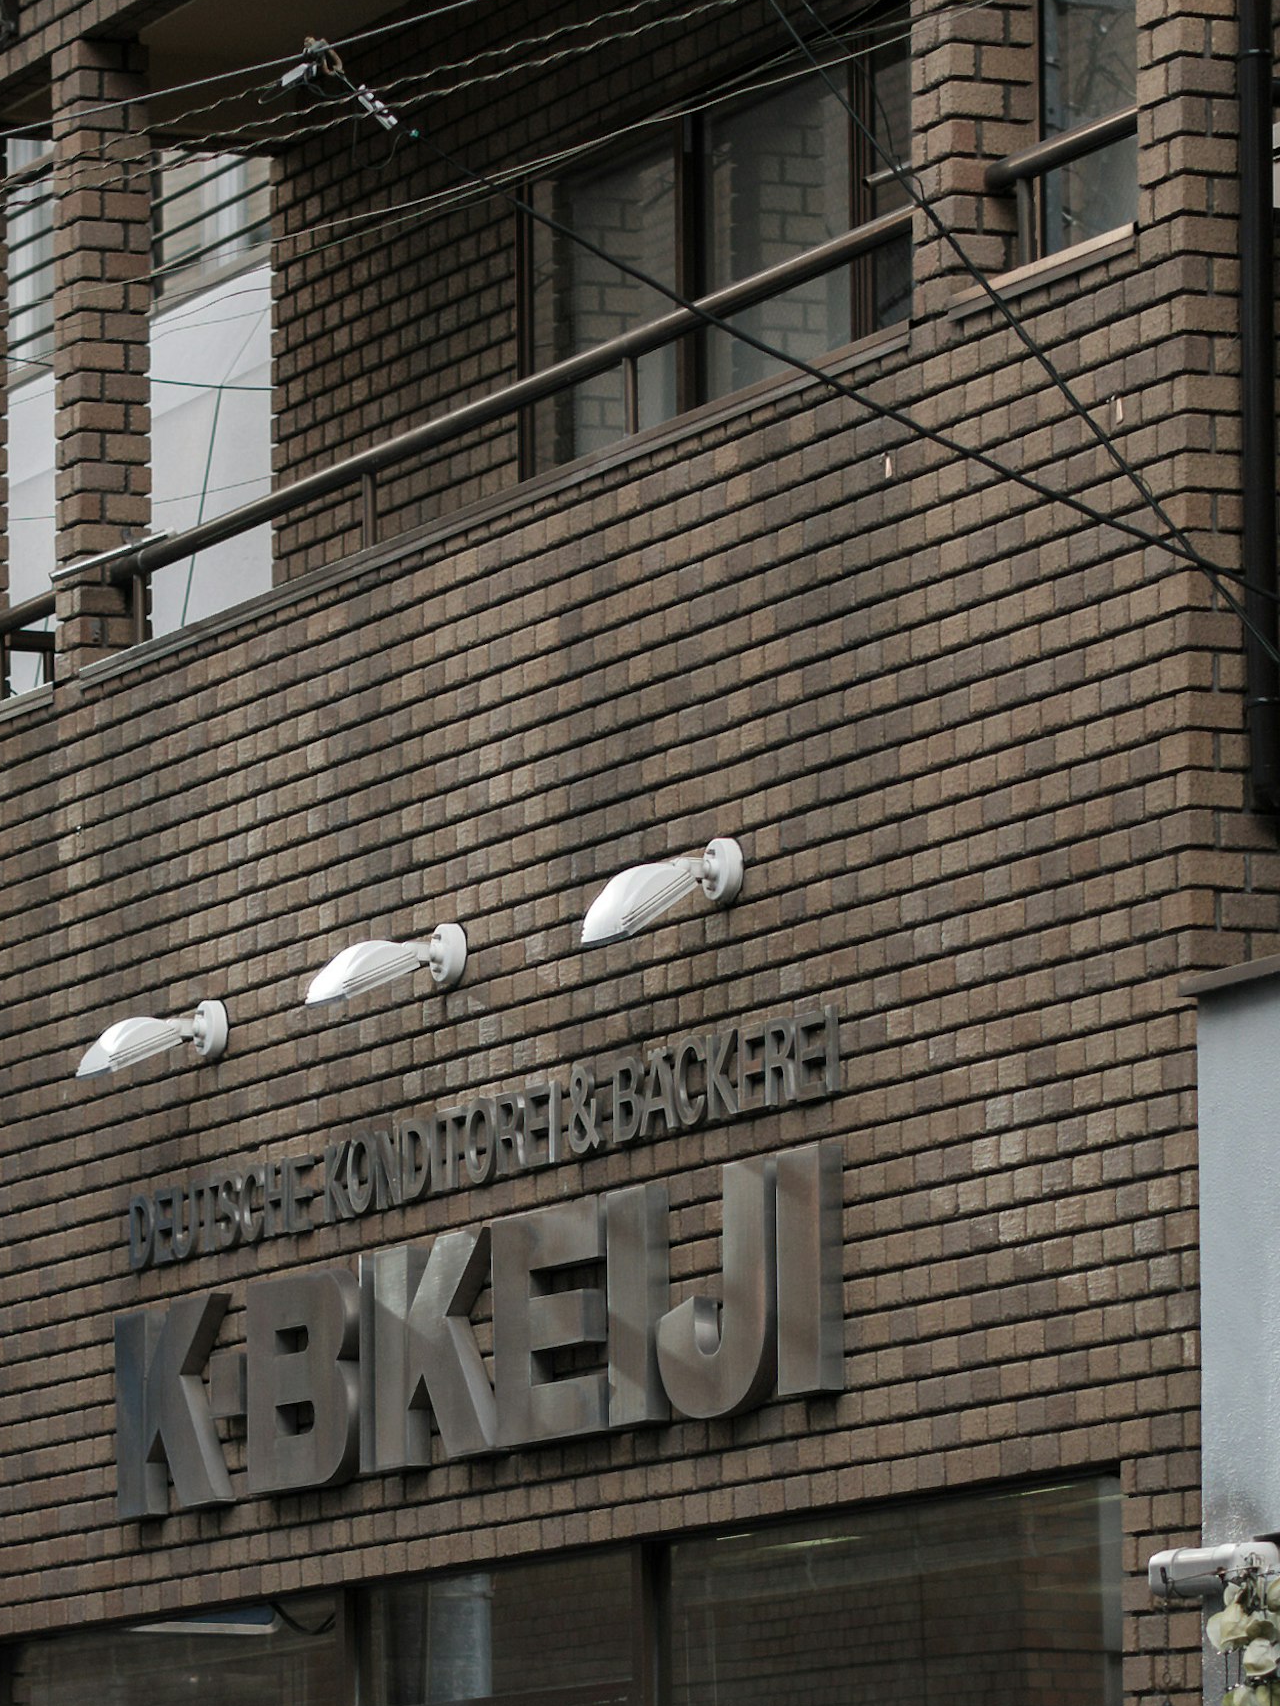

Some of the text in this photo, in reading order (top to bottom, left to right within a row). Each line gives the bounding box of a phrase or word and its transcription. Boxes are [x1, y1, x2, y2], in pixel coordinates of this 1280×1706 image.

[129, 1004, 841, 1272] DEUTSCHE KONDITOREI & BÄCKEREI
